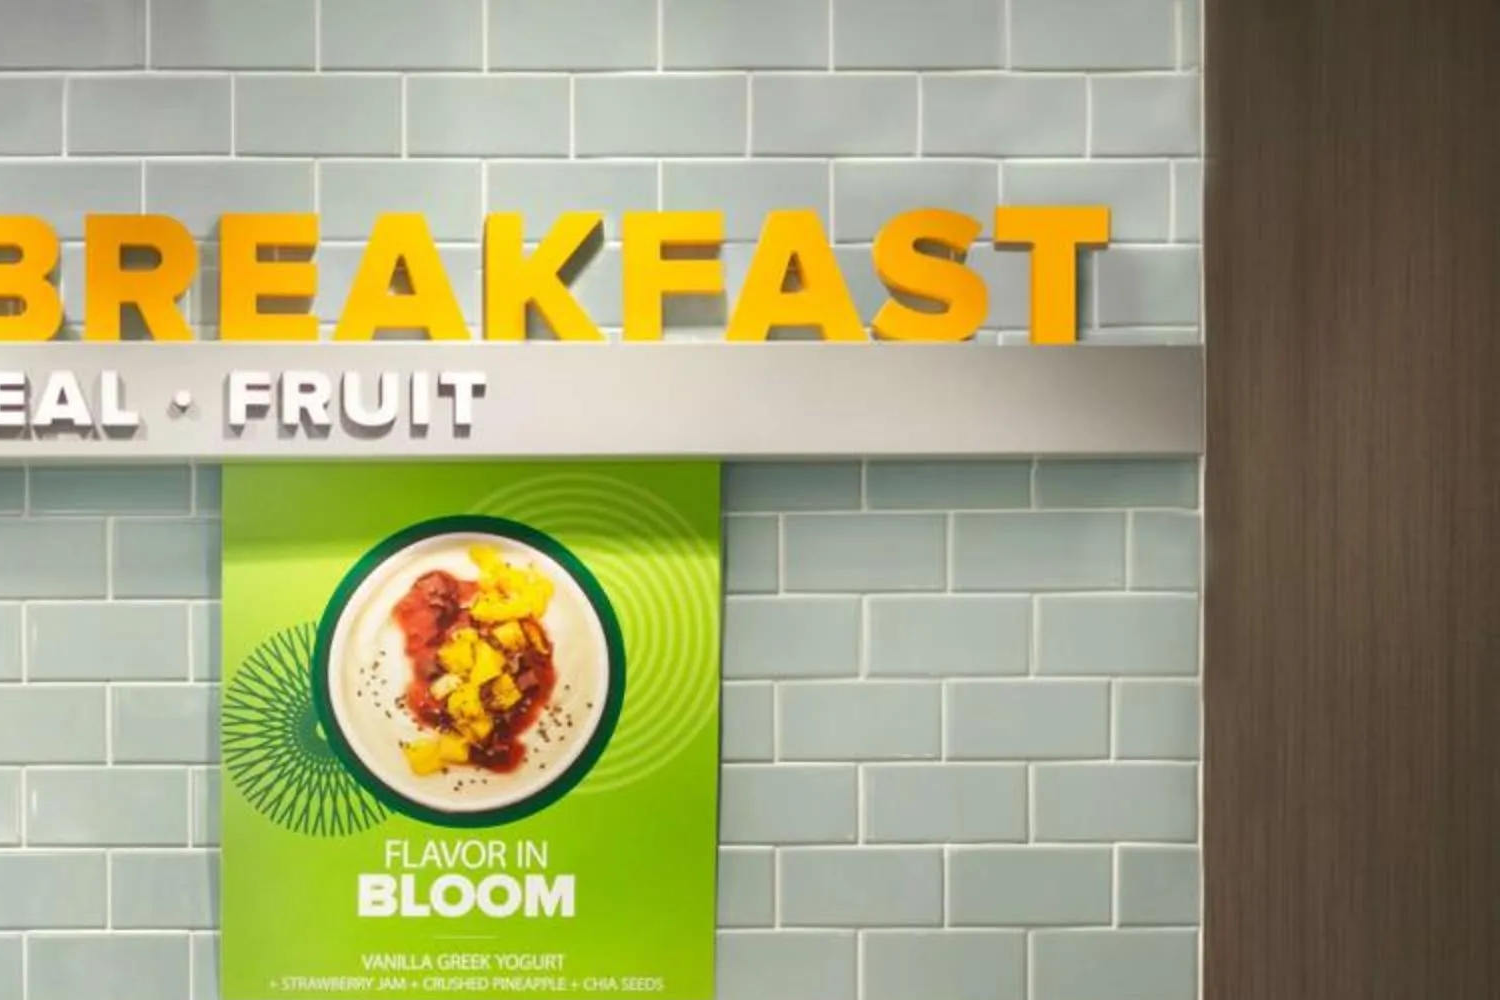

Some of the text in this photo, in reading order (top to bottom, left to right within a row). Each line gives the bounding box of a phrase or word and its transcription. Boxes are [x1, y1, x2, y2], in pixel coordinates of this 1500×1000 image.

[227, 370, 487, 436] FRUIT
[384, 840, 548, 869] FLAVOR IN
[356, 873, 577, 919] BLOOM
[361, 953, 567, 972] VANILLA GREEK YOGURT
[281, 976, 374, 993] STRAWBERRY
[376, 976, 408, 993] JAM
[422, 976, 489, 992] CRUSHED
[492, 976, 566, 992] PINEAPPLE
[582, 976, 618, 992] CHIA
[621, 976, 664, 992] SEEDS
